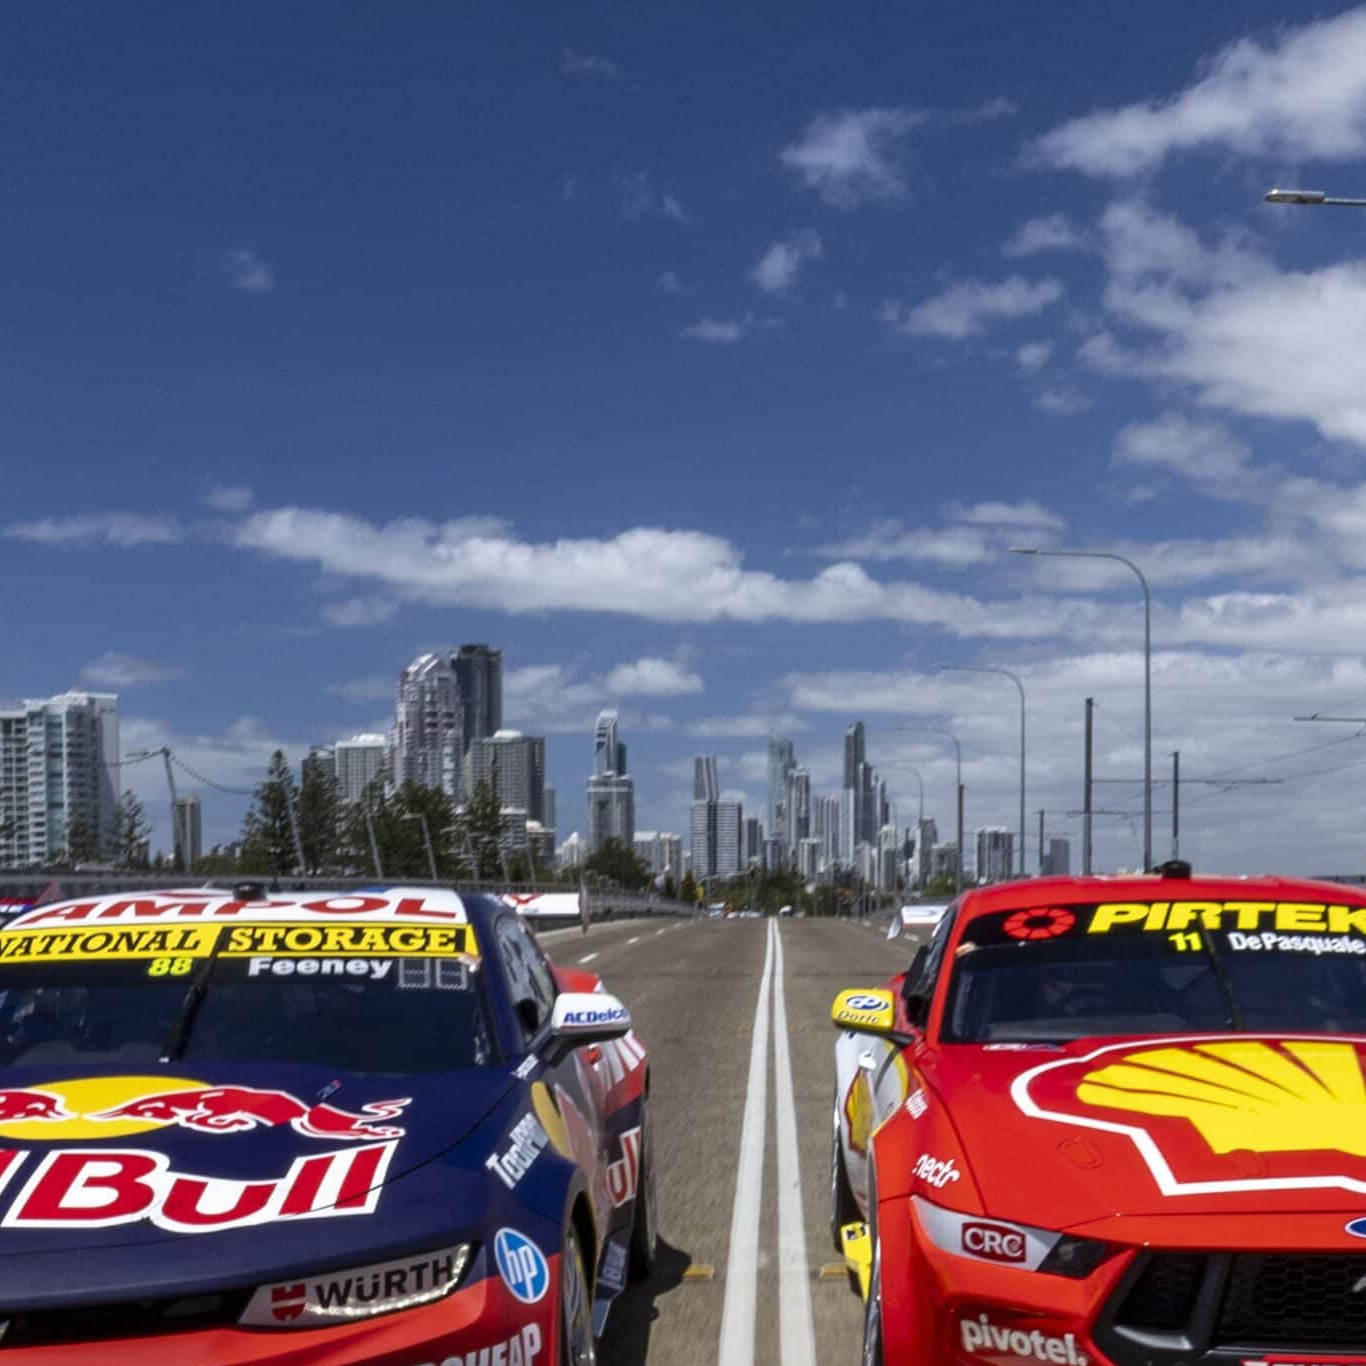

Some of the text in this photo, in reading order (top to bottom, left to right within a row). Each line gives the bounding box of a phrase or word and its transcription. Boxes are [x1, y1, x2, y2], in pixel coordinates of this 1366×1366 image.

[21, 896, 457, 926] AMPOL
[228, 927, 458, 954] STORAGE
[1168, 931, 1203, 951] 11
[147, 958, 193, 977] 88
[248, 957, 394, 979] Feeney
[0, 1141, 399, 1234] Bull
[964, 1226, 1025, 1259] CRC
[499, 1232, 539, 1300] hp
